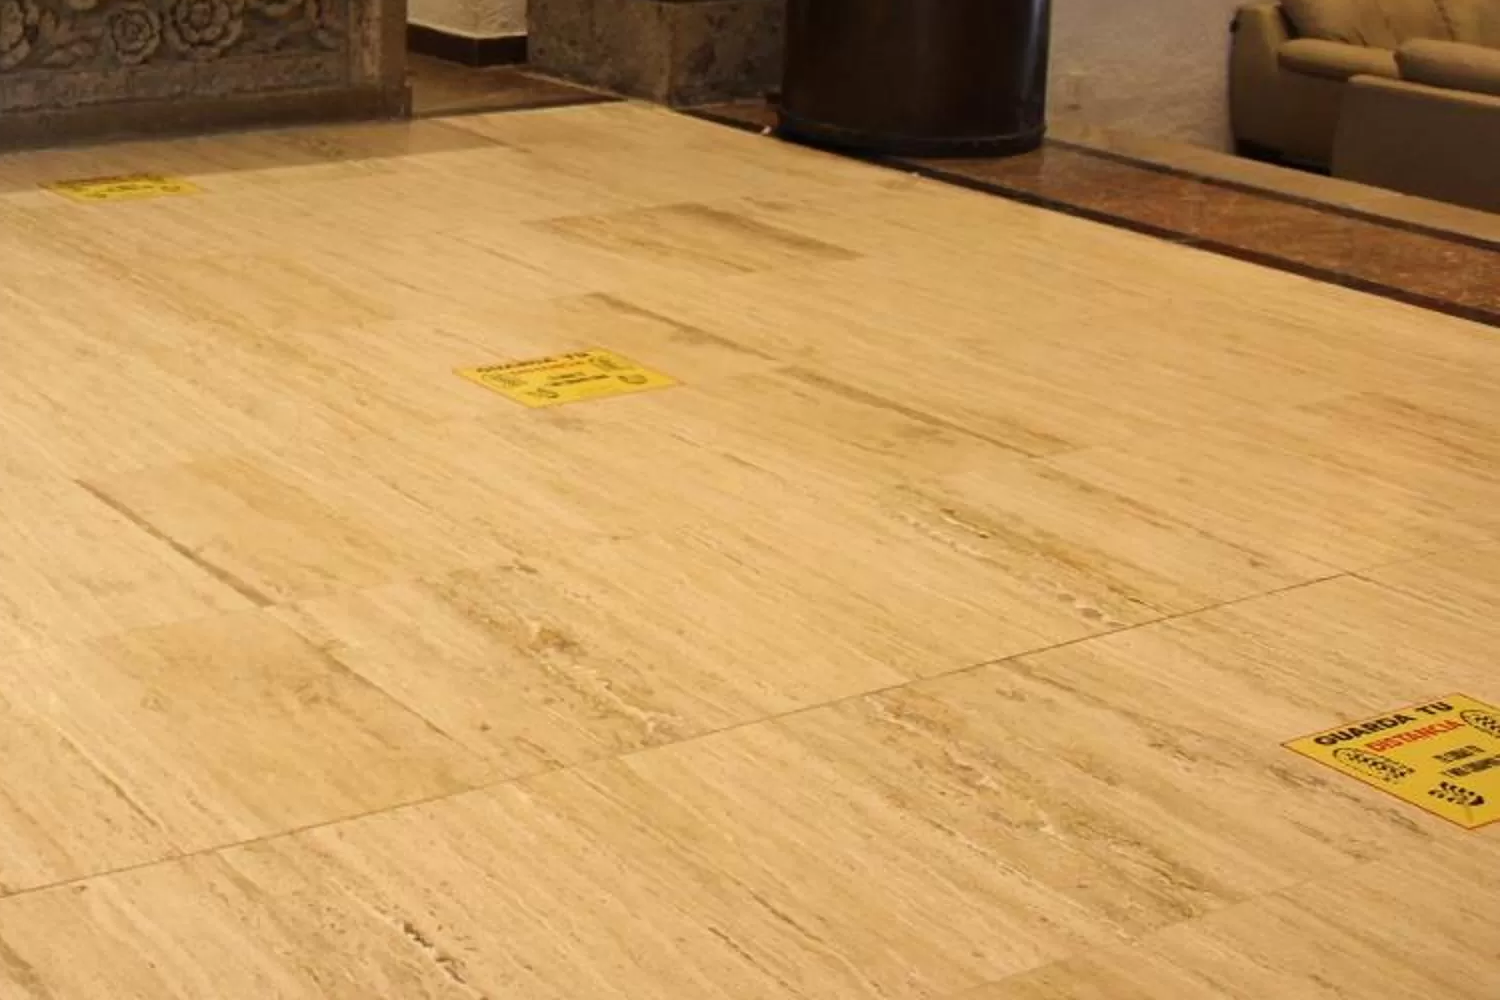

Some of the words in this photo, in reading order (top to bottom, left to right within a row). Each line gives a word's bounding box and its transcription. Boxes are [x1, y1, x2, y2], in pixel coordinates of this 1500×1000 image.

[1313, 713, 1418, 746] GUARDA
[1415, 701, 1454, 715] TU
[1365, 719, 1466, 752] DISTANCIA
